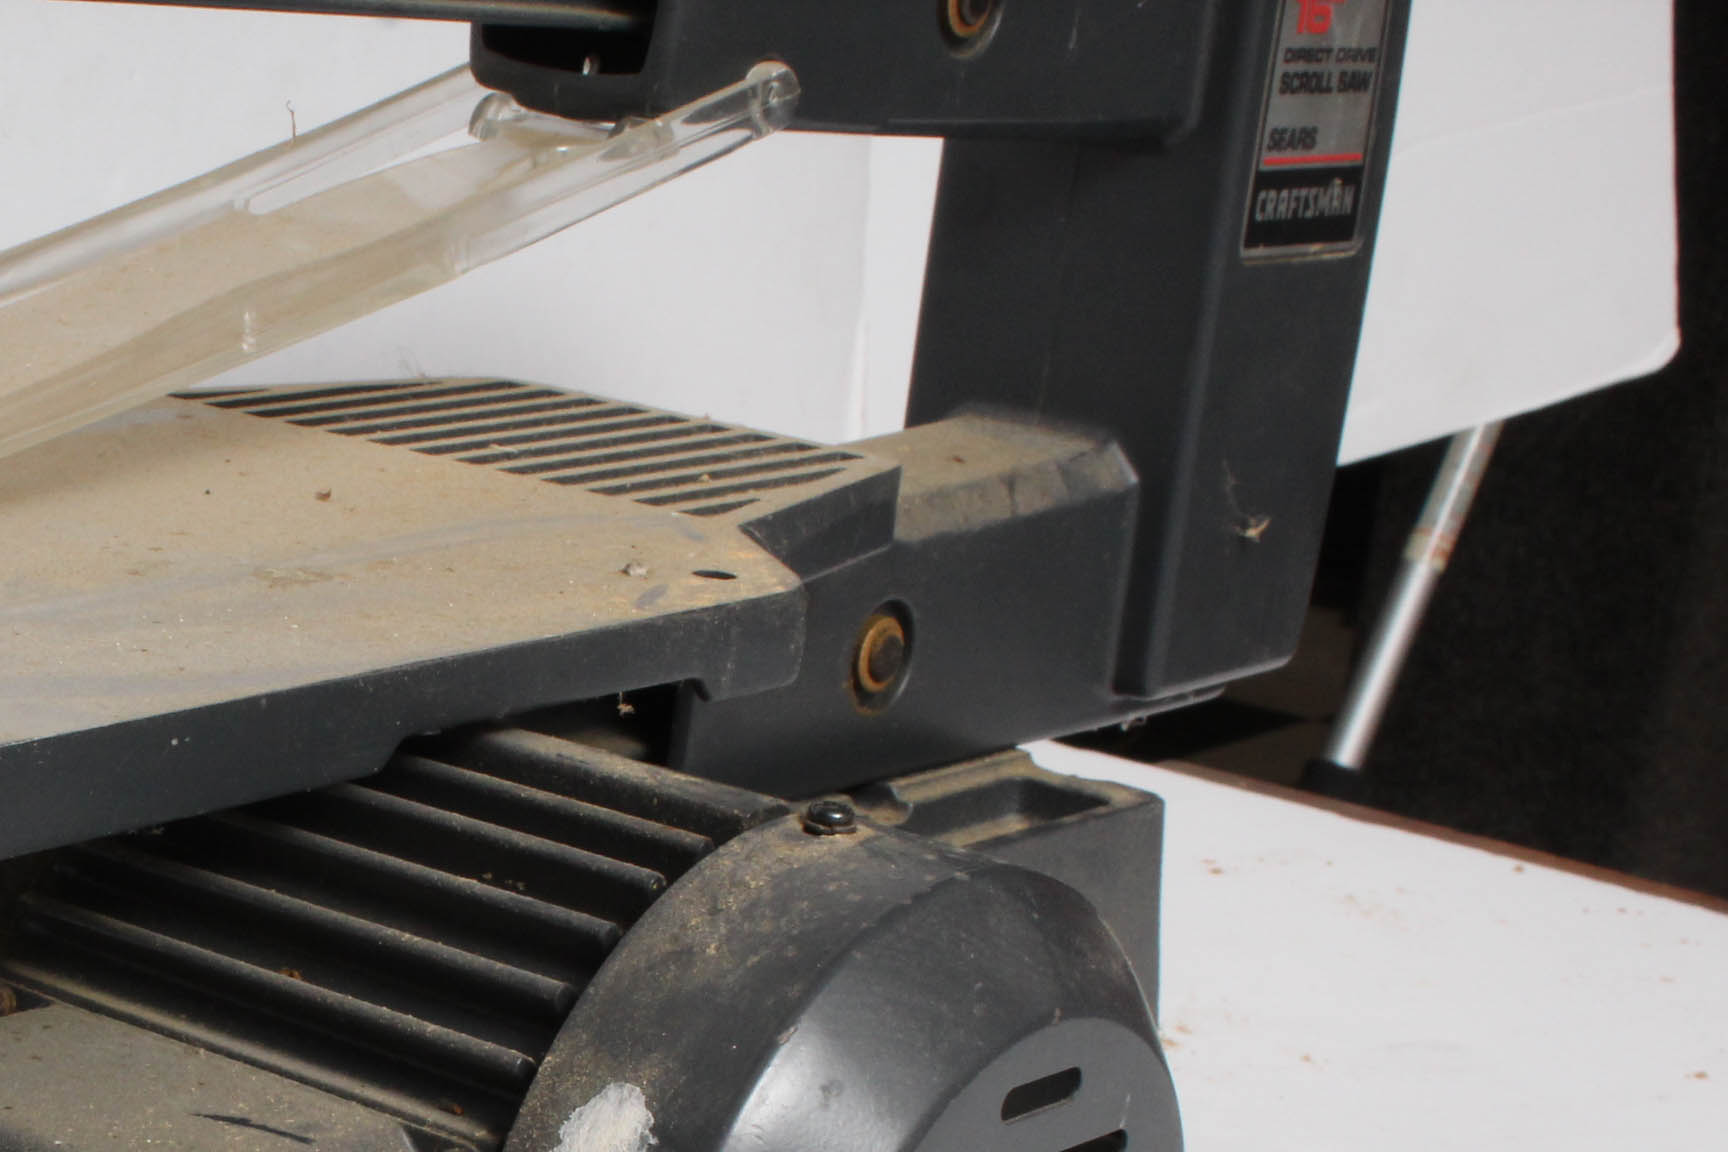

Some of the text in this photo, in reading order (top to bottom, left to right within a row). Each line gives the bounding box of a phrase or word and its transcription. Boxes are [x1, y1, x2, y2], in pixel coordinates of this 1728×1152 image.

[1283, 47, 1376, 63] DIRECT DRIVE
[1279, 69, 1374, 94] SCROLL SAW
[1267, 126, 1318, 151] SEARS
[1255, 177, 1356, 221] CRAFTSMAN
